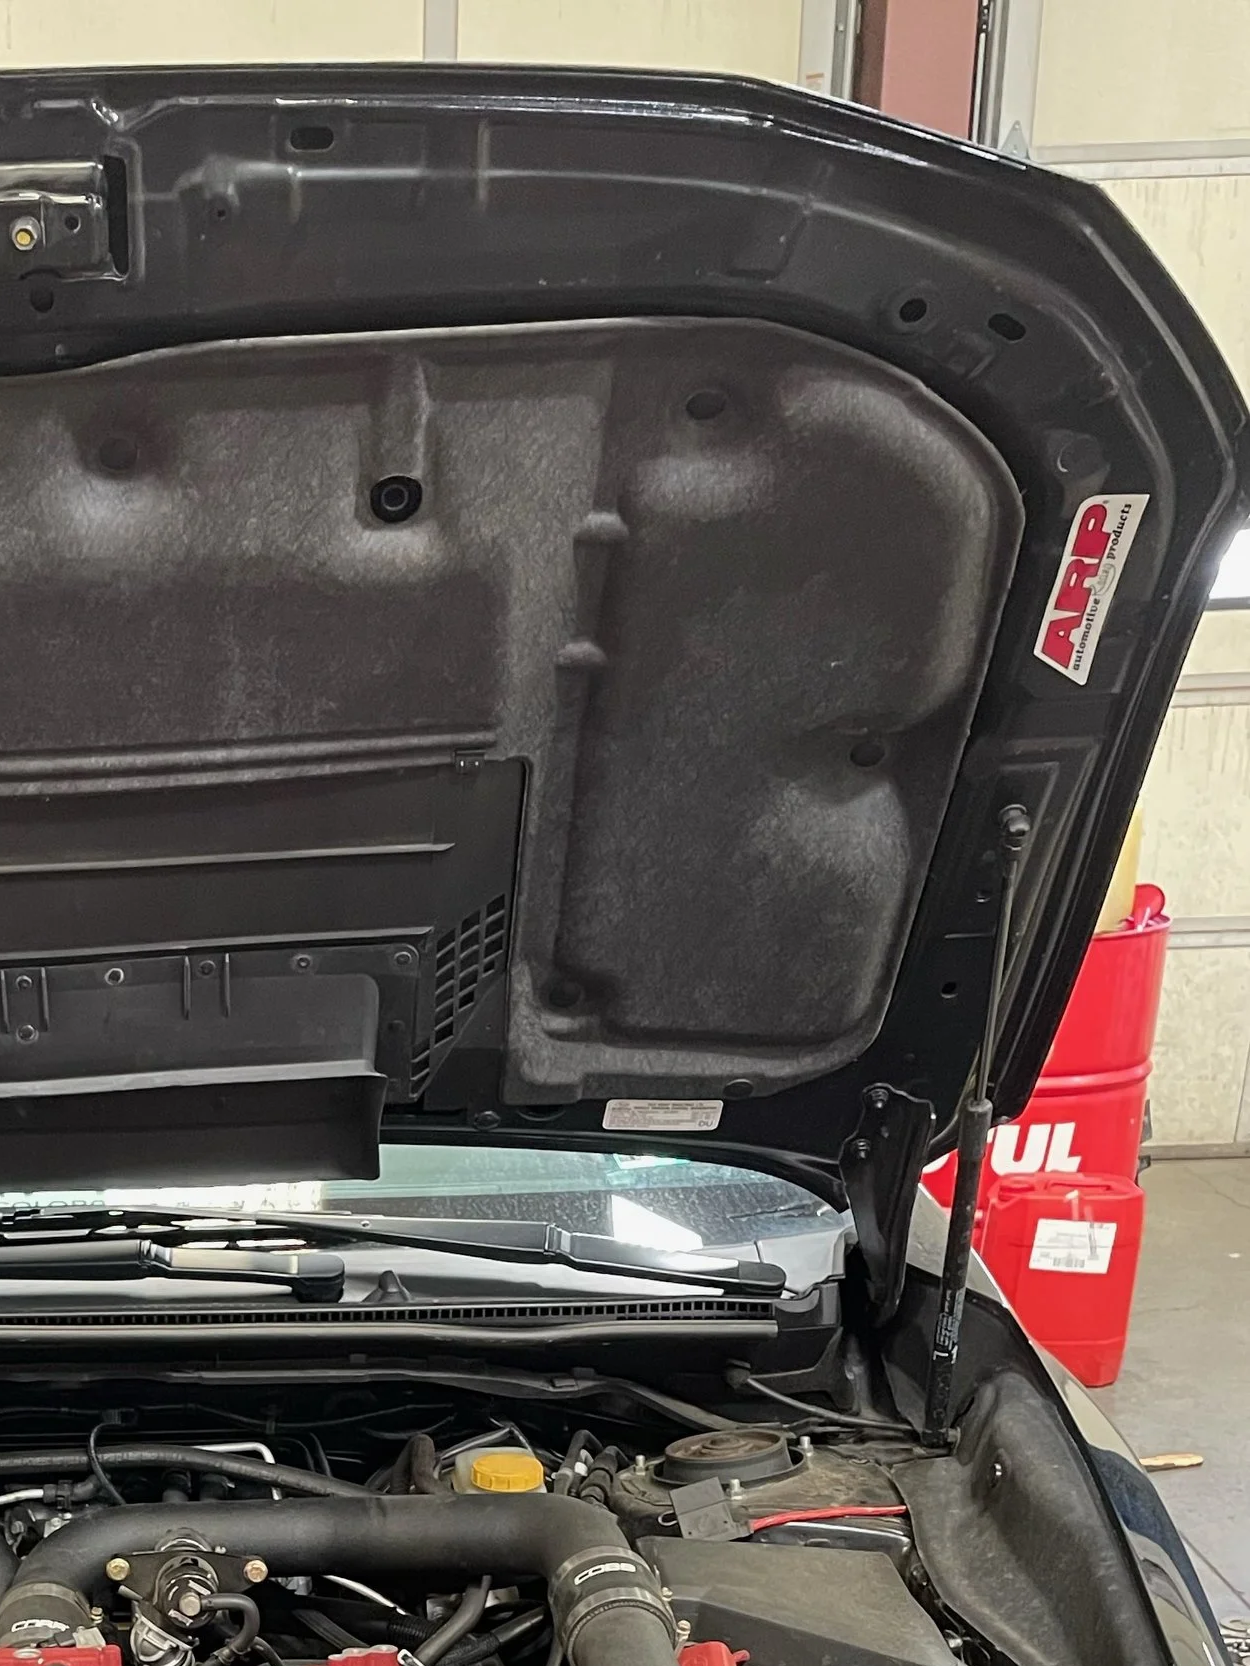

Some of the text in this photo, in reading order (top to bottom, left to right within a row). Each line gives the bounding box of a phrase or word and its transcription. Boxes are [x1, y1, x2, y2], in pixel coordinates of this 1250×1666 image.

[1041, 503, 1111, 669] ARP
[1073, 503, 1132, 671] automotive products
[574, 1562, 636, 1586] COBB
